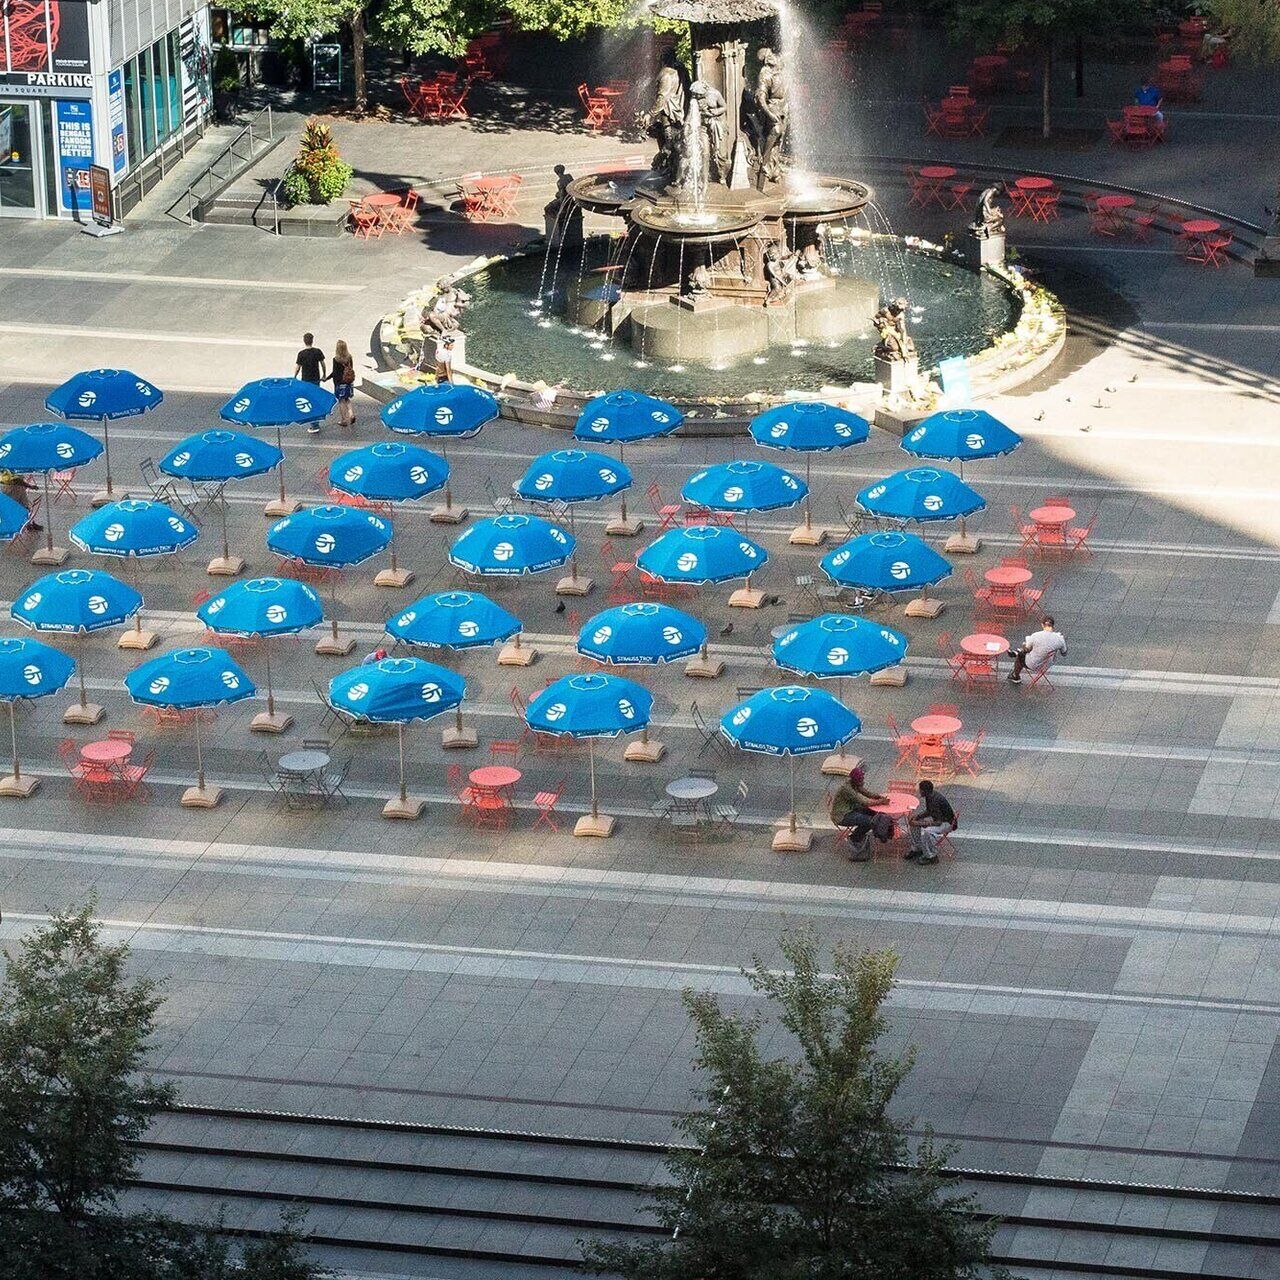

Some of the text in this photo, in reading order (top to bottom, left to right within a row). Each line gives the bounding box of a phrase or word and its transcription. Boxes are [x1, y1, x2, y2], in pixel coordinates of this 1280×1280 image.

[27, 72, 93, 88] PARKING
[60, 121, 90, 131] THIS IS
[61, 149, 92, 157] BETTER
[744, 741, 766, 749] STRAUSS
